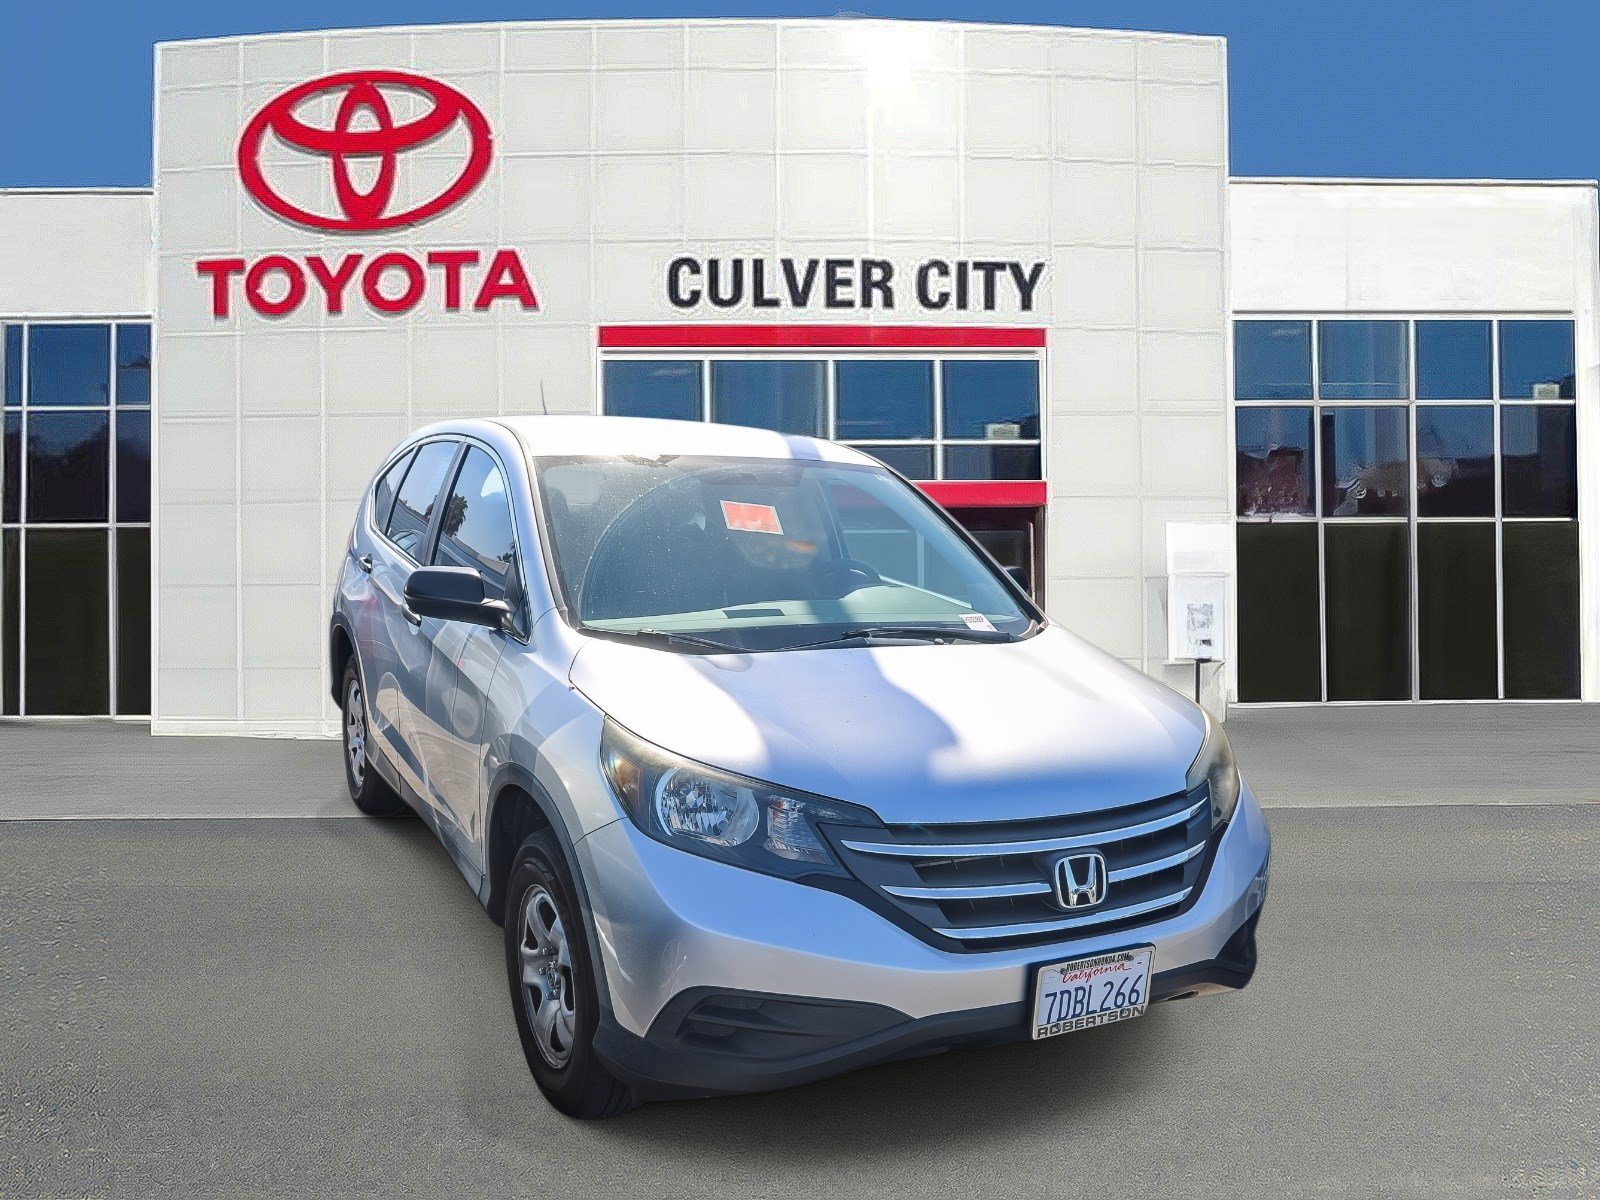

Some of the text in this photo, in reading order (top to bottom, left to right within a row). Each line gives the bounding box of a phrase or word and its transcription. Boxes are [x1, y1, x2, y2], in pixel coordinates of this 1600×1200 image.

[196, 250, 538, 318] TOYOTA
[667, 257, 1045, 312] CULVER CITY
[1062, 962, 1131, 984] California
[1037, 1005, 1144, 1039] ROBERTSON
